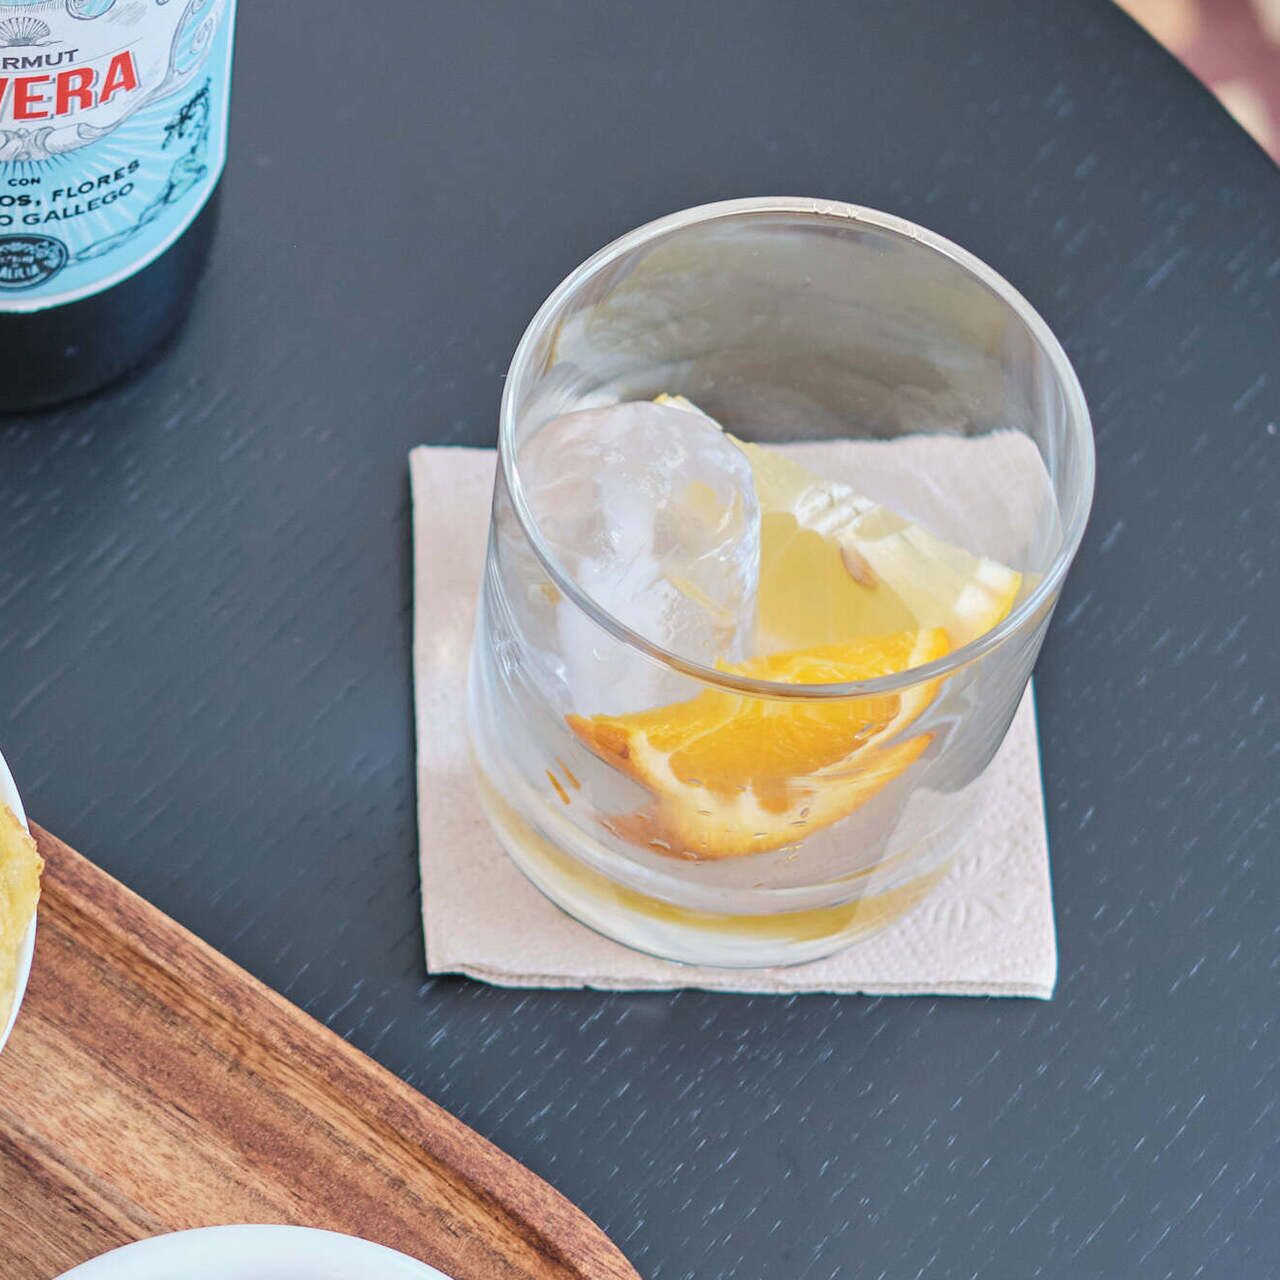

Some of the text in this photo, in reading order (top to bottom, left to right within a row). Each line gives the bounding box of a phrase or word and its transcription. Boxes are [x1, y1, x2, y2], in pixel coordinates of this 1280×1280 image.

[7, 177, 41, 187] CON
[52, 159, 140, 202] FLORES
[22, 182, 135, 225] GALLEGO
